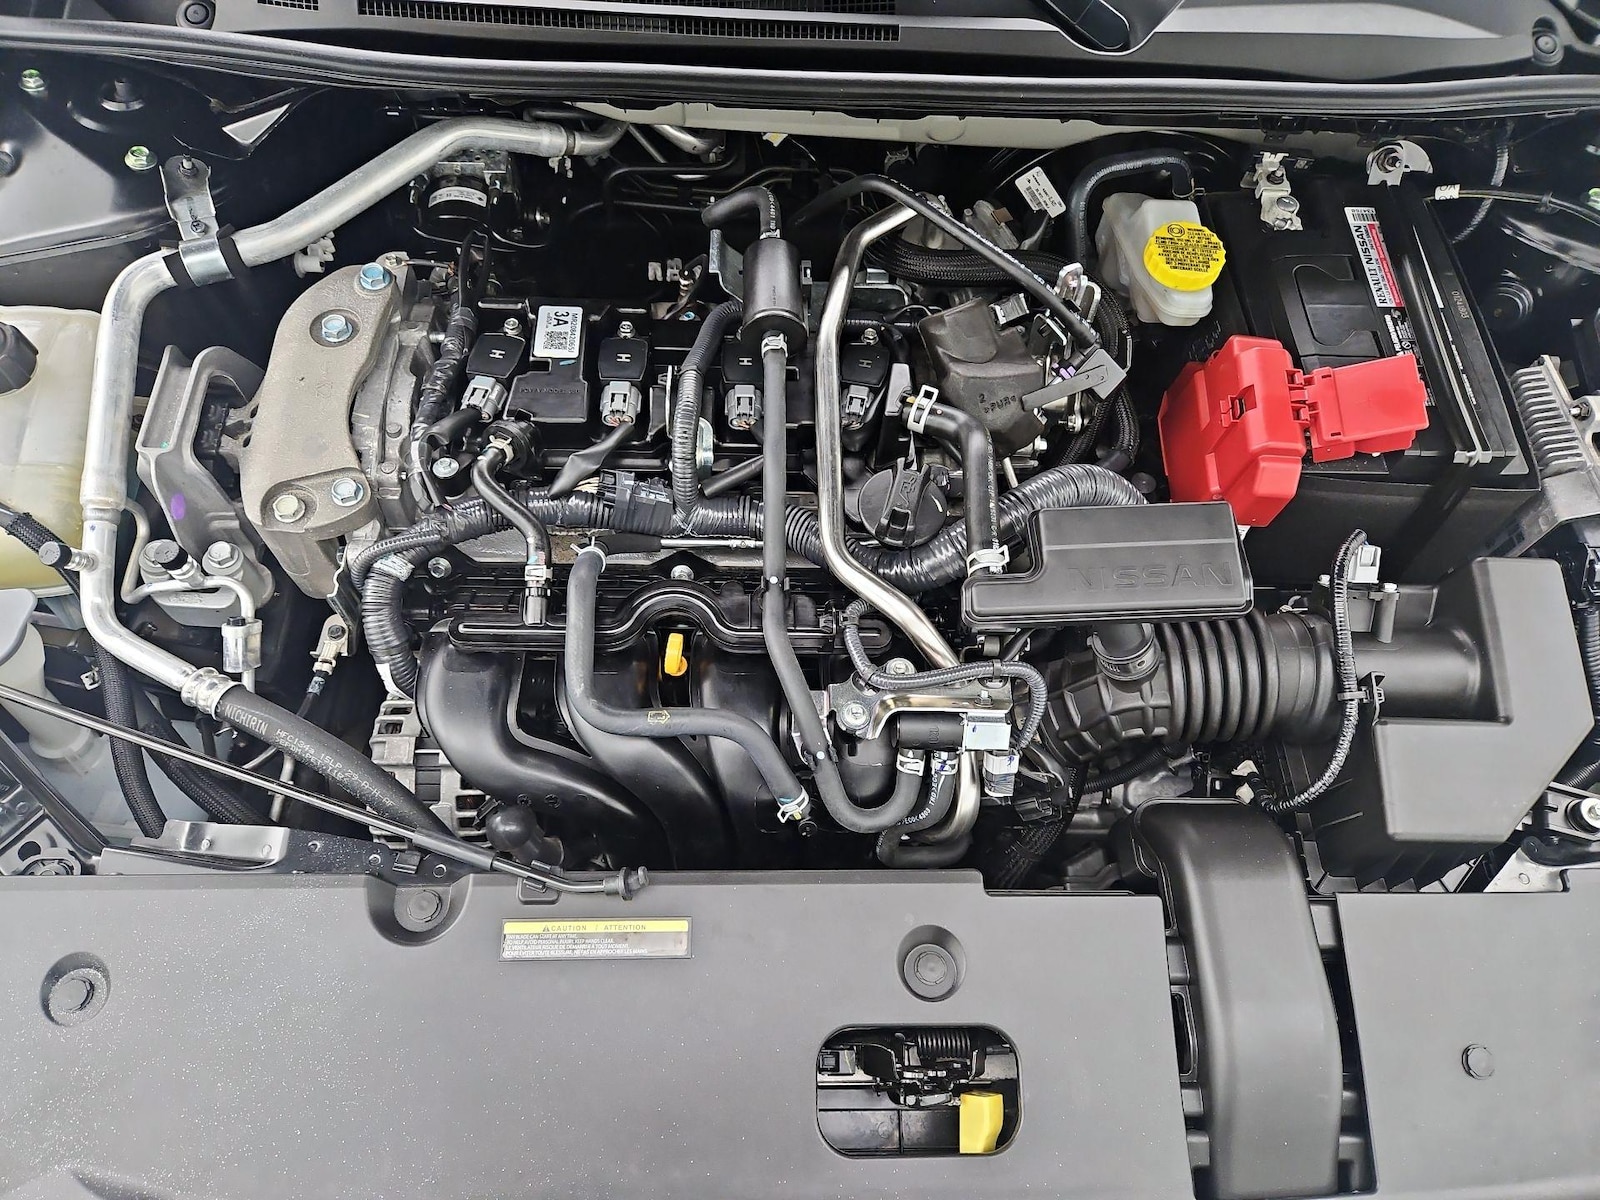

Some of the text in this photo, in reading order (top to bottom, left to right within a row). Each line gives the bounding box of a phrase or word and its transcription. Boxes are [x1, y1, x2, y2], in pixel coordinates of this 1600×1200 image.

[1353, 225, 1373, 264] NISSAN
[1367, 266, 1387, 303] RENAULT
[553, 311, 570, 327] 3A
[1068, 561, 1234, 592] NISSAN
[224, 703, 269, 735] NICHIRIN
